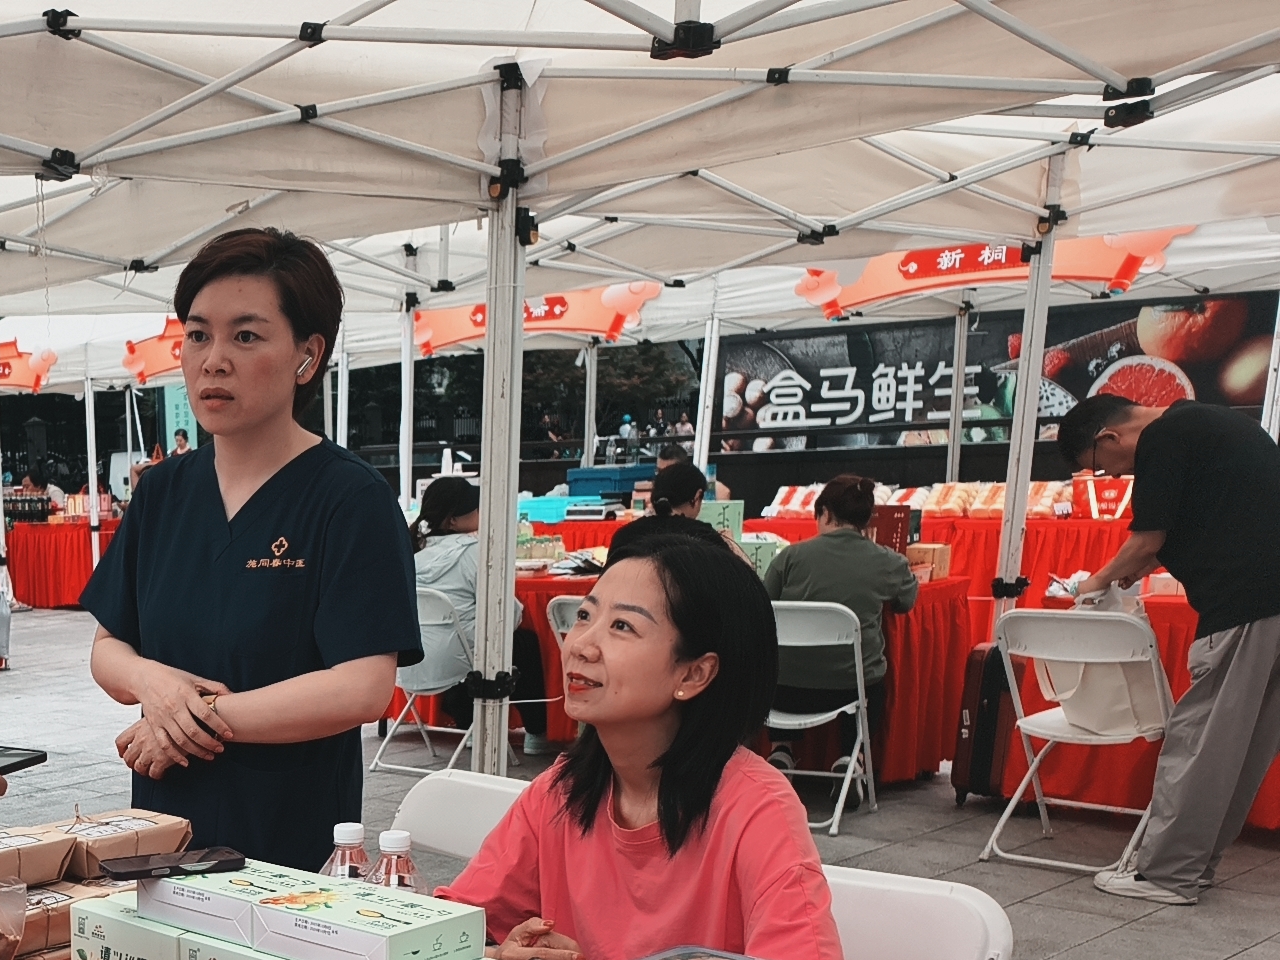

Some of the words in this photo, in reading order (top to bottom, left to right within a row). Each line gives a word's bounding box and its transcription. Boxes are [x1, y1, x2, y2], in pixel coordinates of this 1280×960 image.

[936, 244, 1007, 271] 新桐
[756, 360, 982, 429] 盒马鲜生
